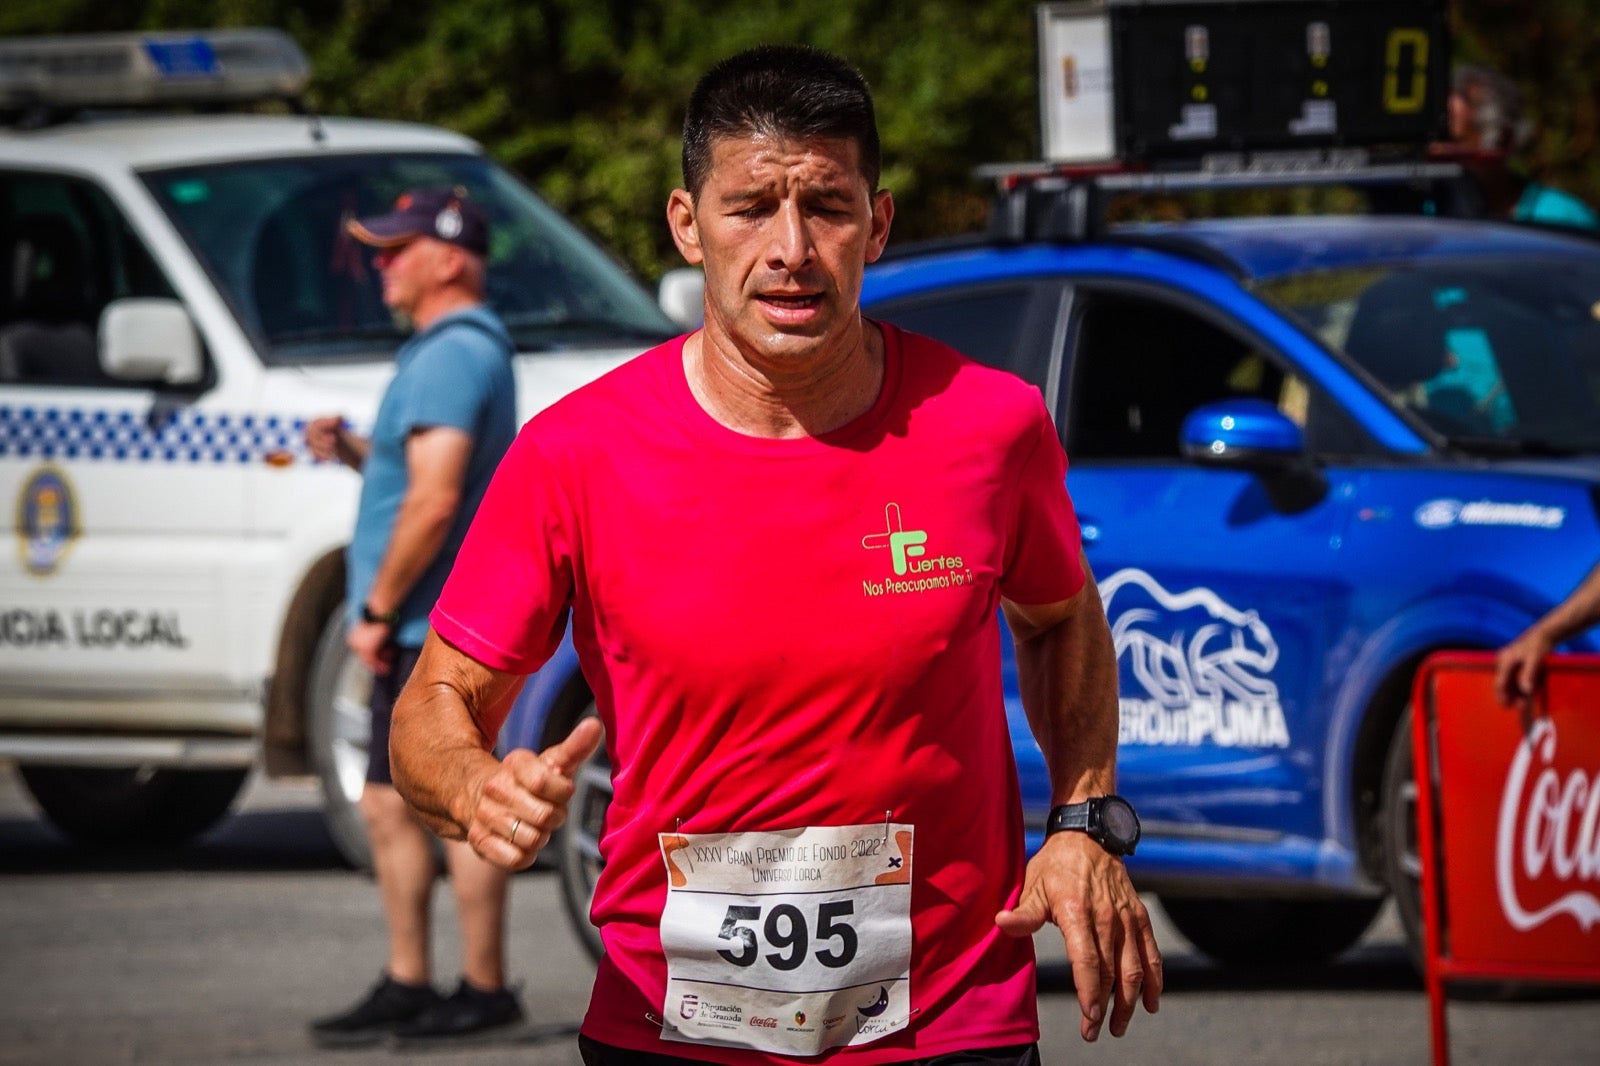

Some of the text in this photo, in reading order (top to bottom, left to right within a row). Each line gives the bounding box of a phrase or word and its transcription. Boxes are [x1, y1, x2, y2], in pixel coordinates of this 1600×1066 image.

[862, 577, 884, 597] Nos
[885, 576, 950, 595] Preocupamos
[949, 570, 965, 587] Por
[0, 607, 190, 649] ICIA LOCAL
[693, 838, 881, 865] XXXV GRAN PREMIO DE FONDO 2022
[751, 866, 822, 883] UNIVERSO LORCA
[716, 899, 859, 971] 595
[700, 1001, 742, 1014] Diputación
[709, 1011, 742, 1022] Granada
[855, 1014, 888, 1035] Lorca
